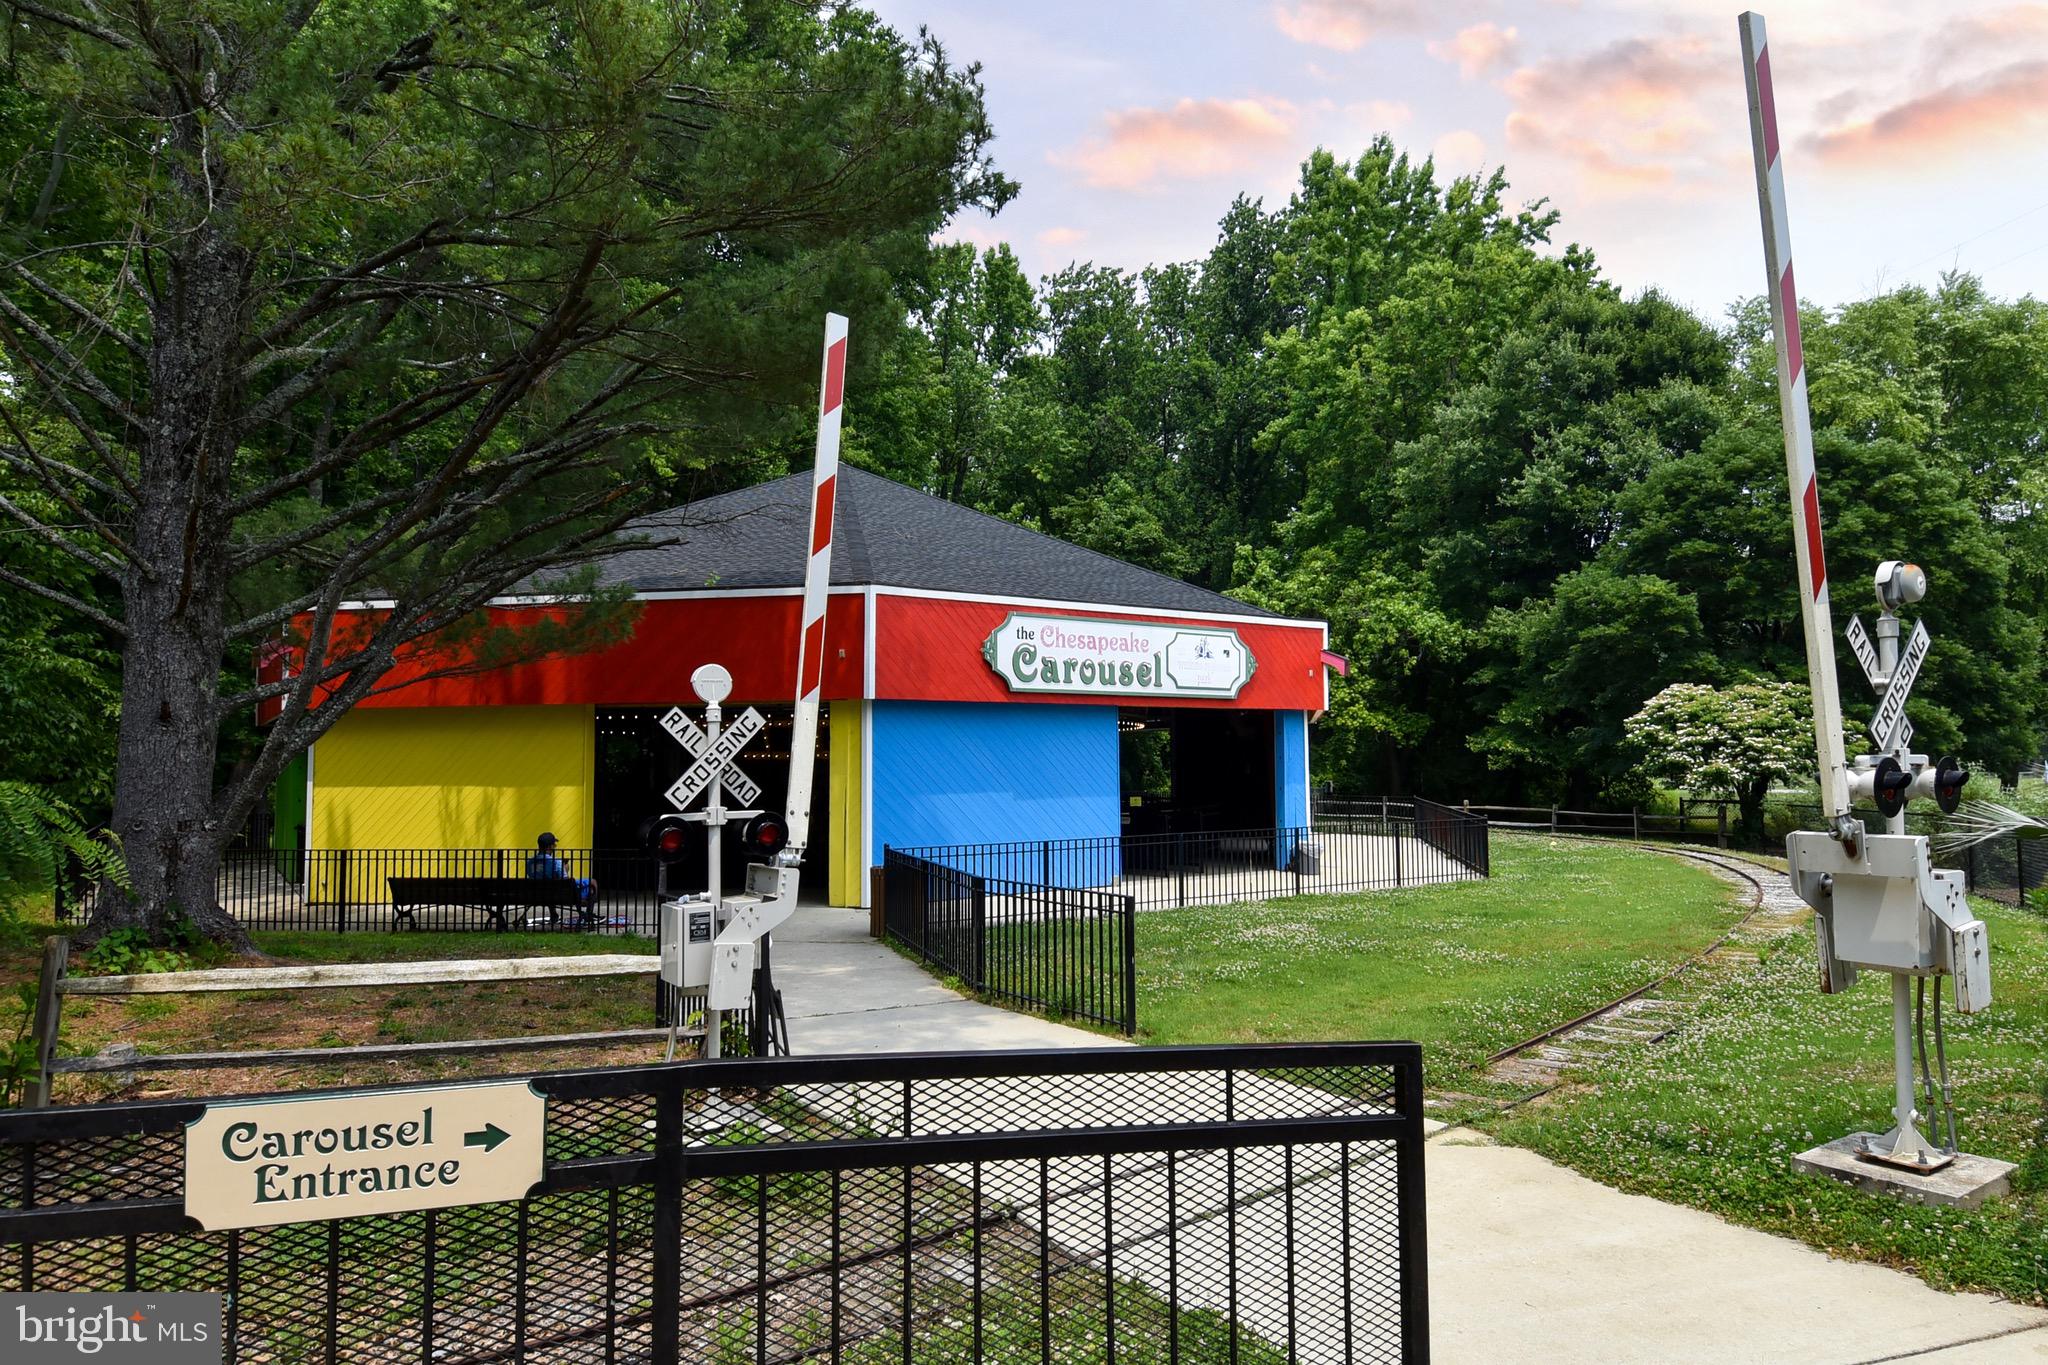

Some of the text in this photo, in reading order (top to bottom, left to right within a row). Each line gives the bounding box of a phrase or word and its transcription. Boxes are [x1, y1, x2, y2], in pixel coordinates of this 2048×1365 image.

[1016, 624, 1149, 655] the Chesapeake
[1850, 622, 1875, 678] RAIL
[1012, 643, 1163, 687] Carousel
[1875, 632, 1925, 743] CROSSING
[665, 711, 703, 754] RAIL
[671, 715, 758, 805] CROSSING
[720, 762, 757, 803] ROAD
[221, 1106, 434, 1162] Carousel
[252, 1159, 460, 1204] Entrance
